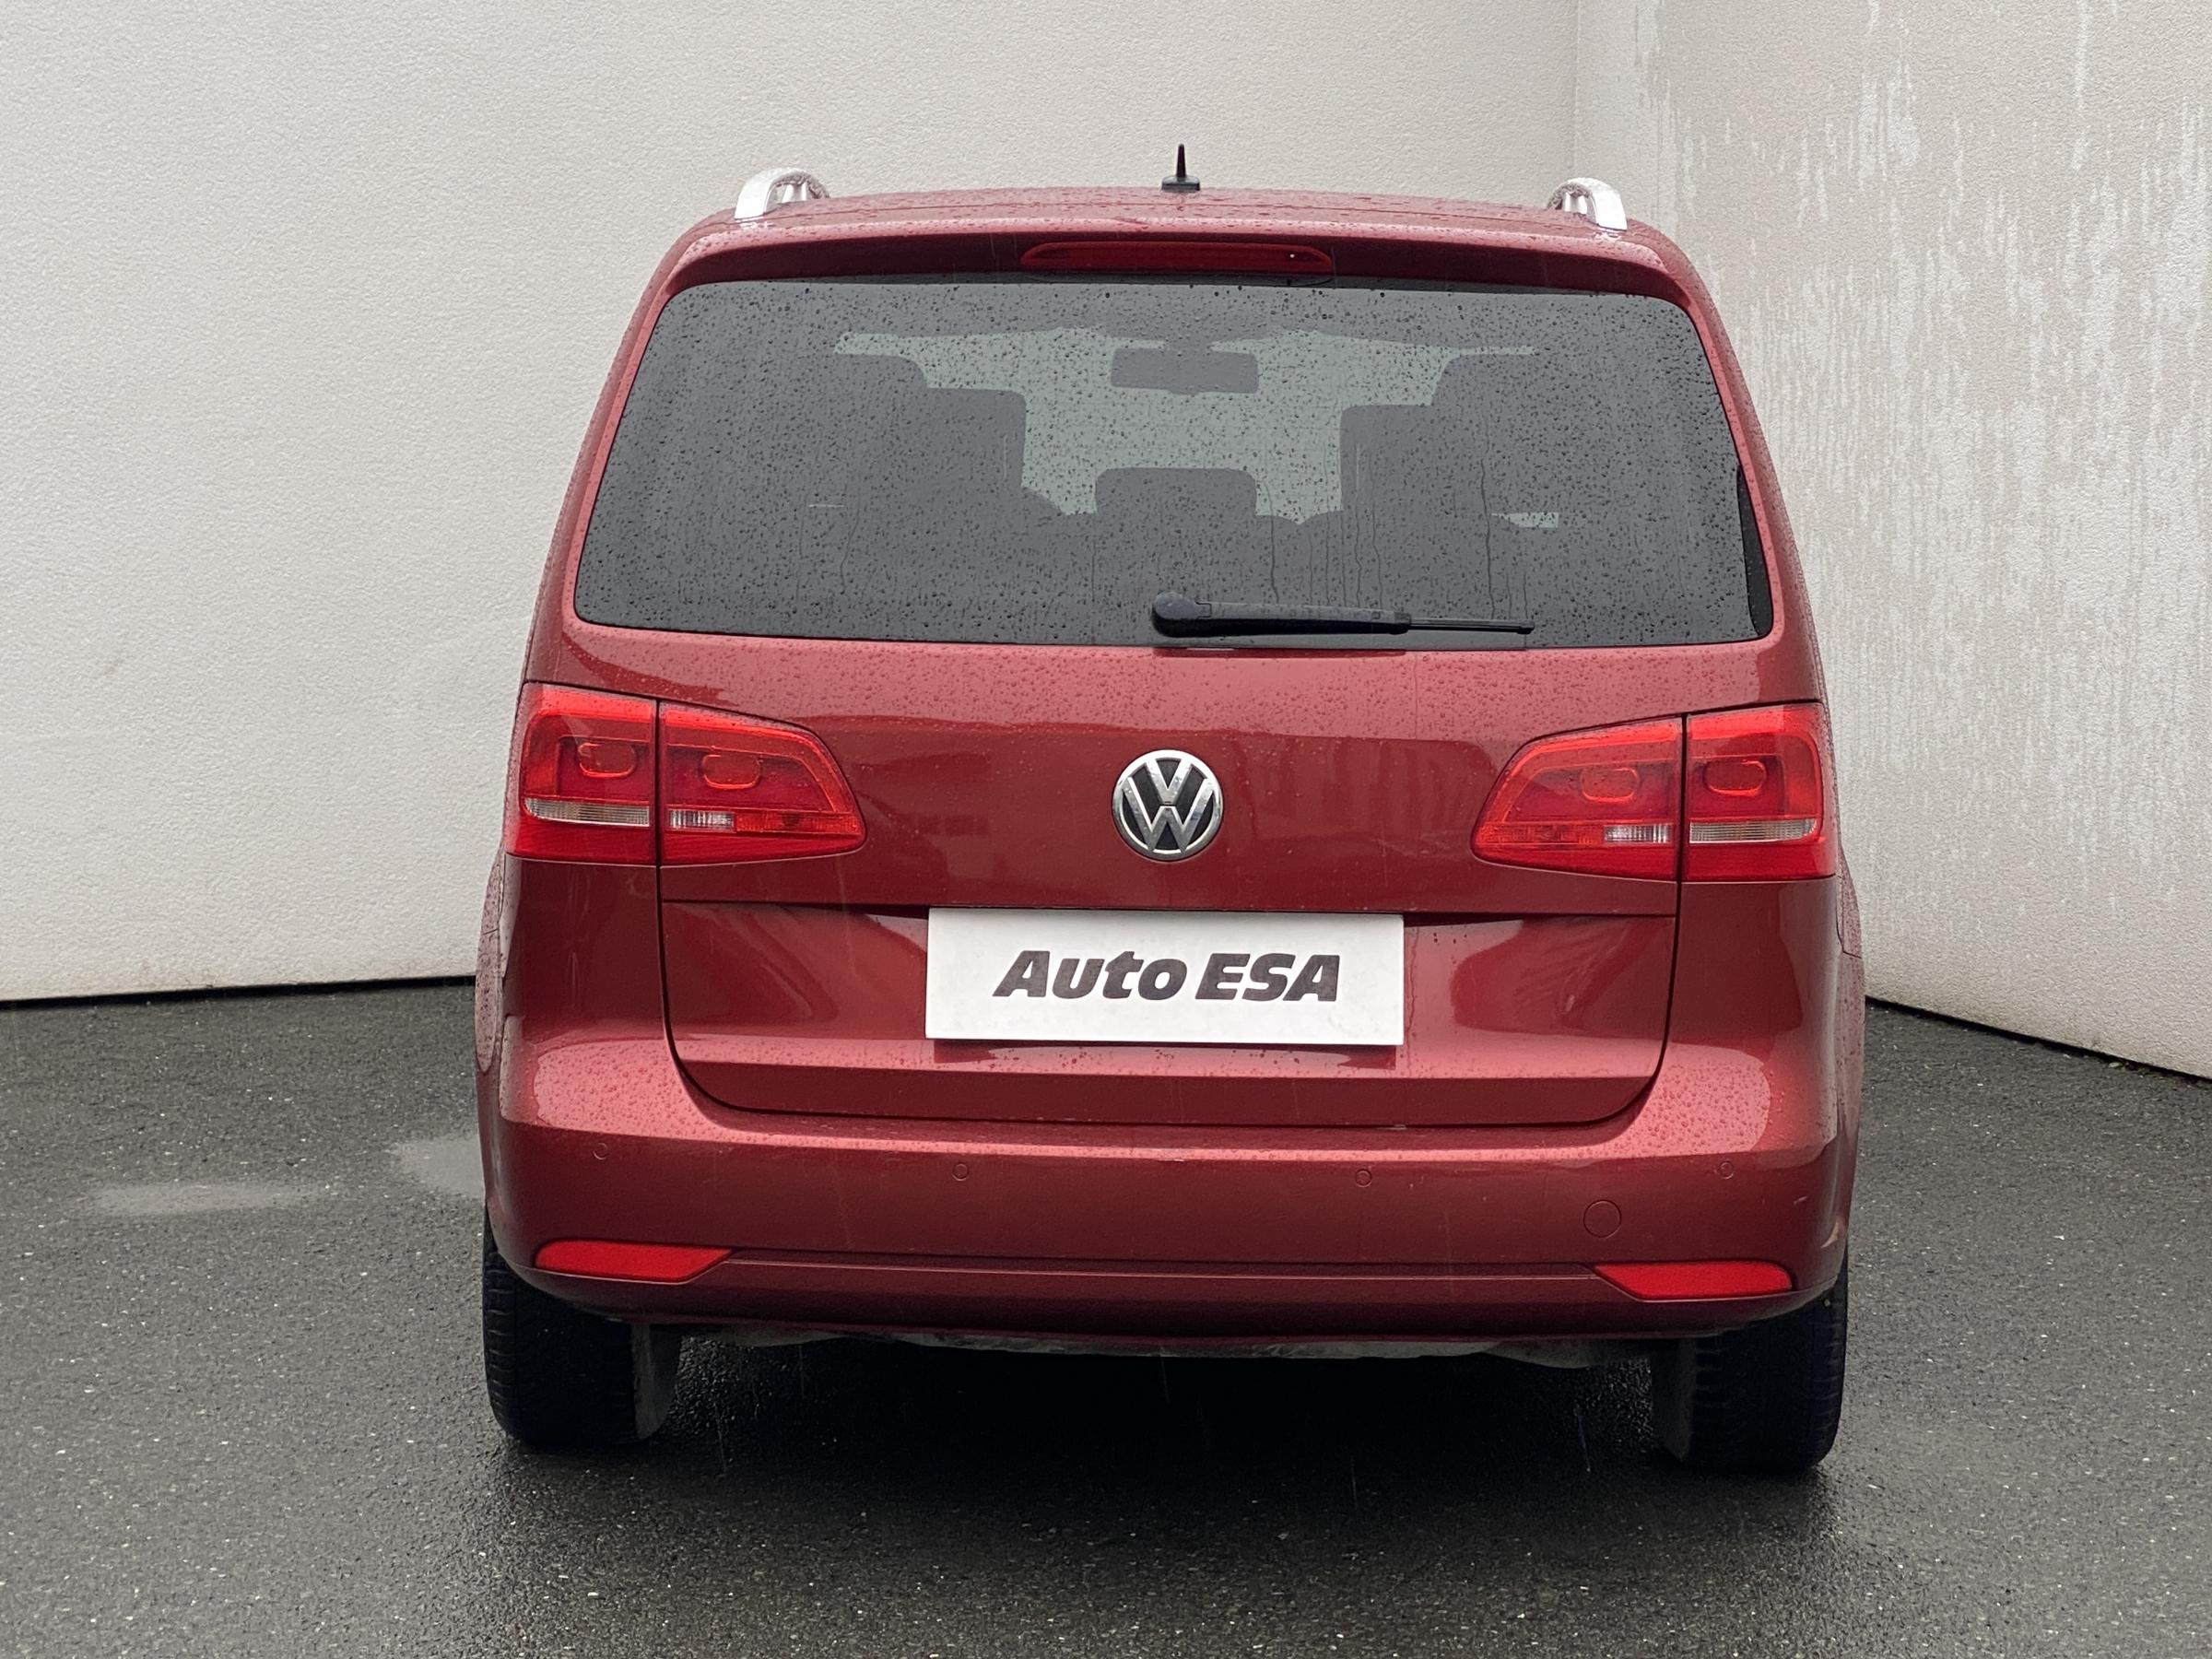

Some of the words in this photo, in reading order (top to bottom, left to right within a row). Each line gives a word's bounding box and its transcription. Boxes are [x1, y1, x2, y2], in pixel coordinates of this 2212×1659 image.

[1116, 753, 1220, 857] VW
[993, 950, 1188, 1000] Auto
[1195, 953, 1341, 1002] ESA
